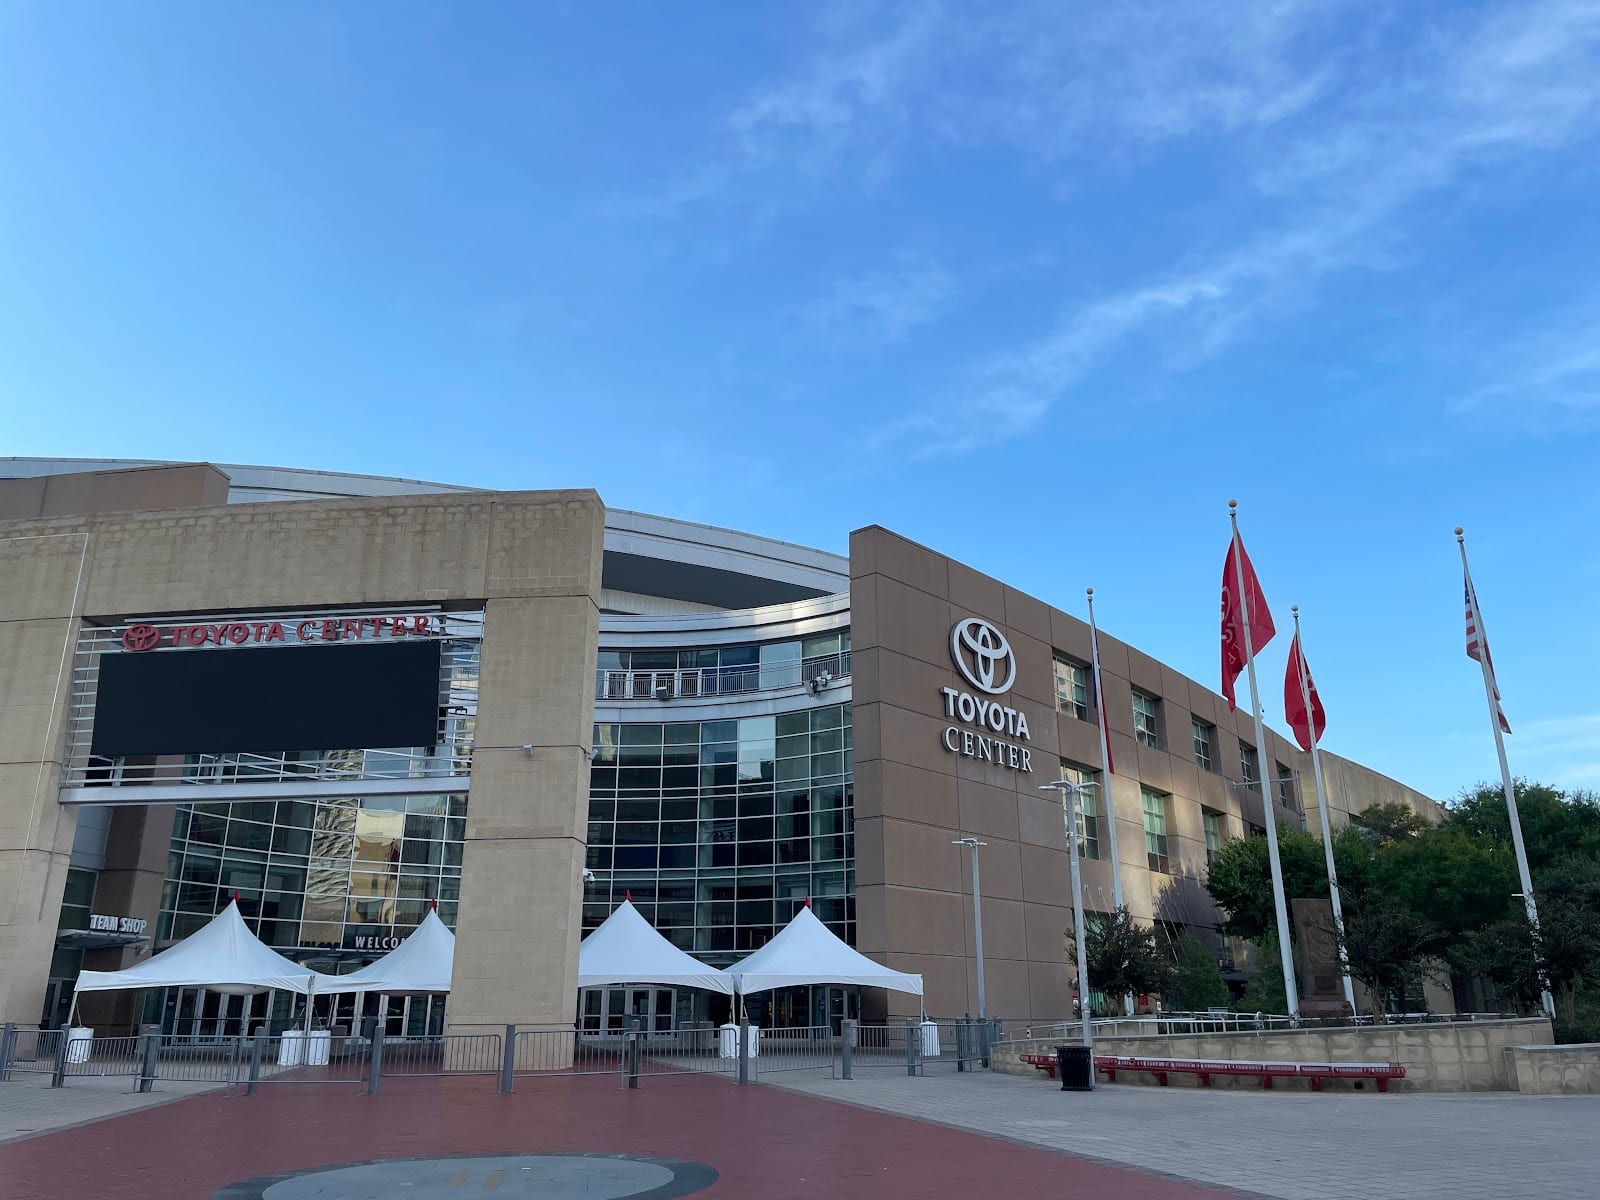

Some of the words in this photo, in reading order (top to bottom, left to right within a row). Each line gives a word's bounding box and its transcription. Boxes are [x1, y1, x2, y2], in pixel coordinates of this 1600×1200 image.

[170, 621, 285, 647] TOYOTA
[296, 615, 431, 641] CENTER
[940, 687, 1031, 741] TOYOTA
[942, 726, 1033, 773] CENTER
[90, 914, 119, 931] TEAM
[120, 917, 148, 933] SHOP
